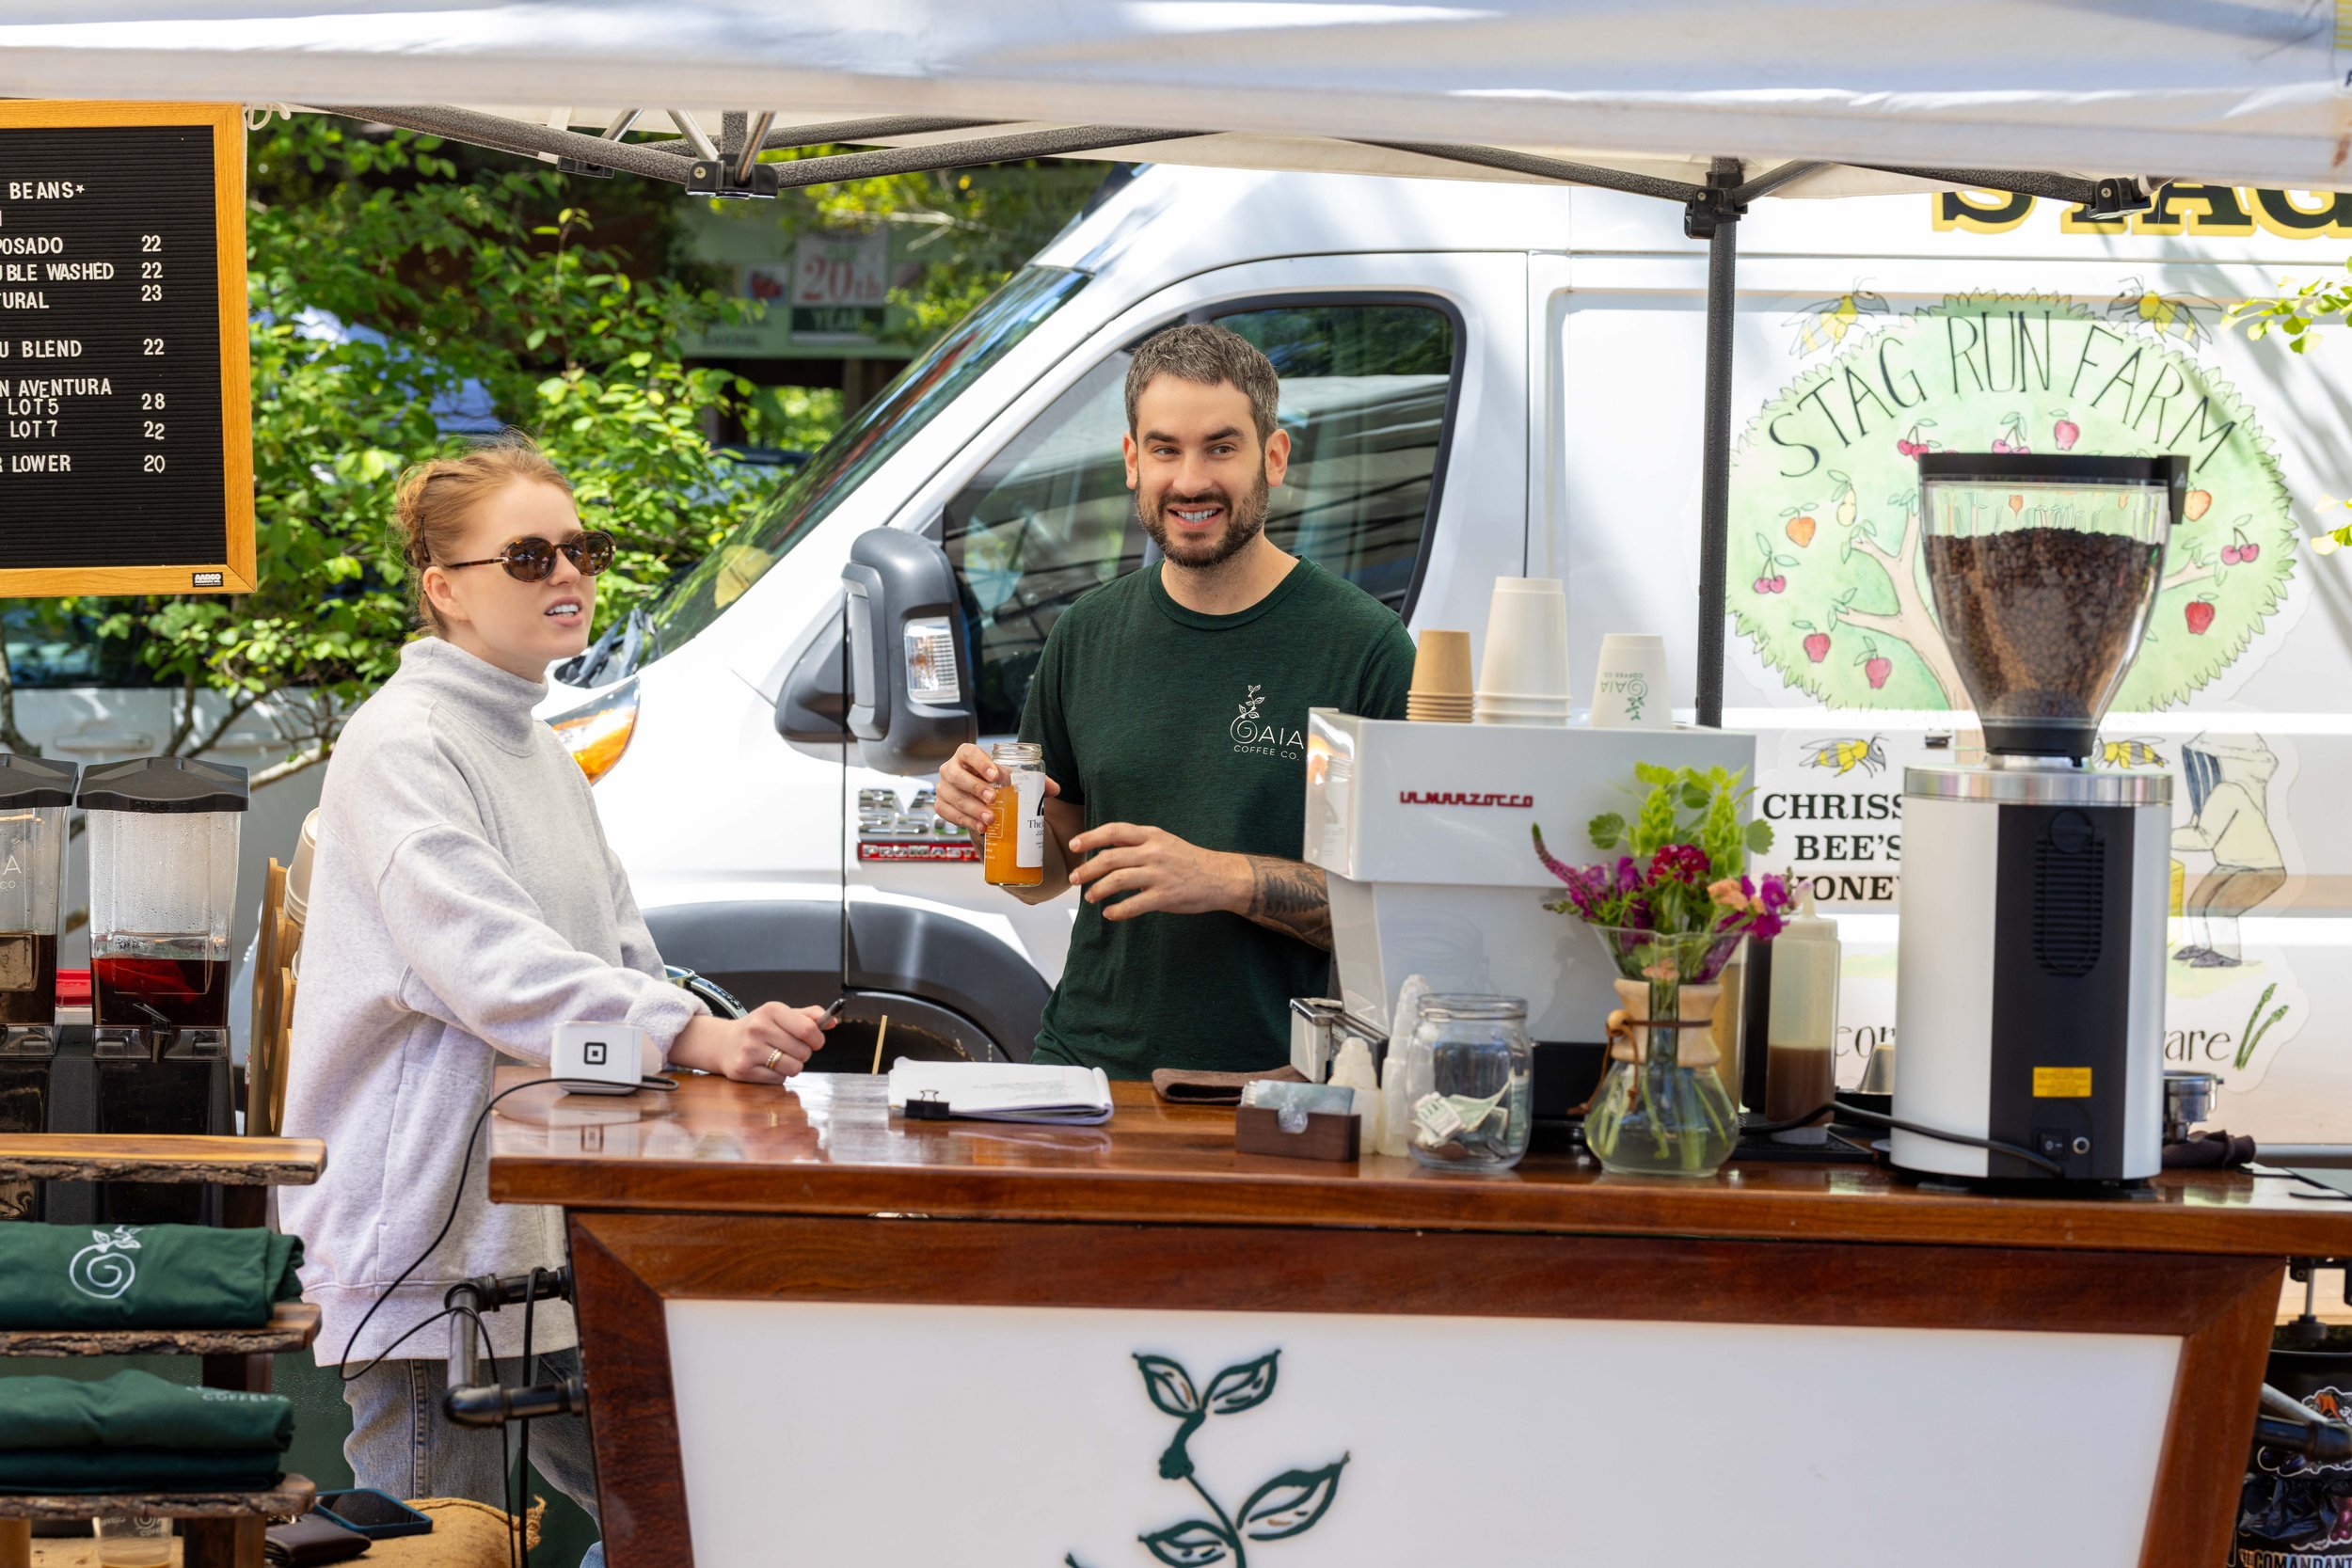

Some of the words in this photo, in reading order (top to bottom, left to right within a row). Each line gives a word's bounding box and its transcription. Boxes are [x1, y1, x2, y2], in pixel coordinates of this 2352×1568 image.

[0, 237, 63, 255] OSADO
[141, 235, 162, 252] 22
[0, 263, 38, 281] BLE
[46, 262, 114, 281] WASHED
[141, 261, 163, 279] 22
[0, 292, 49, 309] URAL
[141, 284, 163, 301] 23
[22, 341, 82, 357] BLEND
[143, 339, 165, 356] 22
[19, 378, 112, 398] AVENTURA
[1769, 337, 1928, 478] STAG
[1948, 309, 2051, 395] RUN
[2070, 325, 2237, 473] FARM
[141, 393, 166, 410] 28
[143, 420, 165, 440] 22
[12, 454, 72, 472] LOWER
[144, 454, 166, 473] 20
[1230, 714, 1304, 750] GAIA
[1233, 745, 1276, 756] COFFEE
[1280, 751, 1299, 761] CO.
[862, 845, 979, 858] PROMAST
[1790, 876, 1900, 901] ONE
[2164, 1030, 2231, 1062] are
